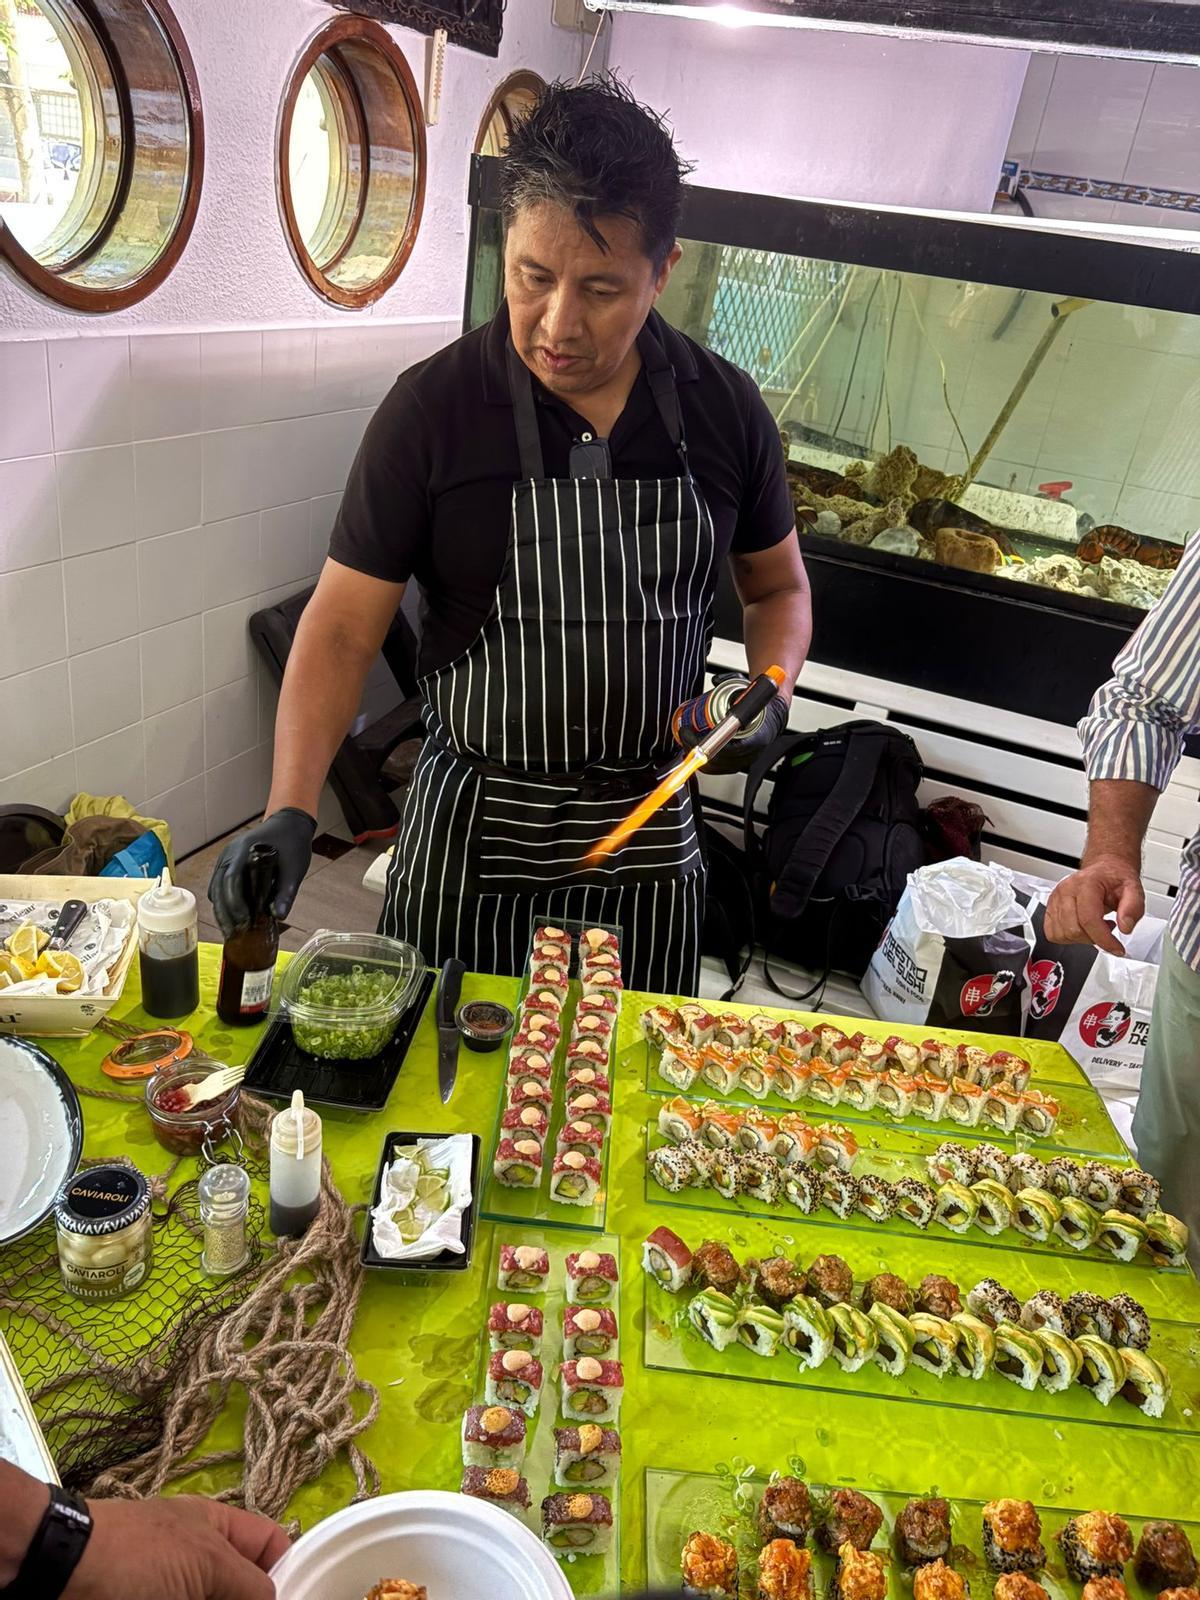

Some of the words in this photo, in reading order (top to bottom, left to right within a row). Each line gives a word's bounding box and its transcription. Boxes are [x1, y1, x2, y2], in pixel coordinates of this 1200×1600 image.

[896, 963, 925, 994] SUSHI
[1091, 1056, 1123, 1068] DELIVERY
[71, 1187, 129, 1203] CAVIAROLI
[66, 1263, 126, 1279] CAVIAROLI
